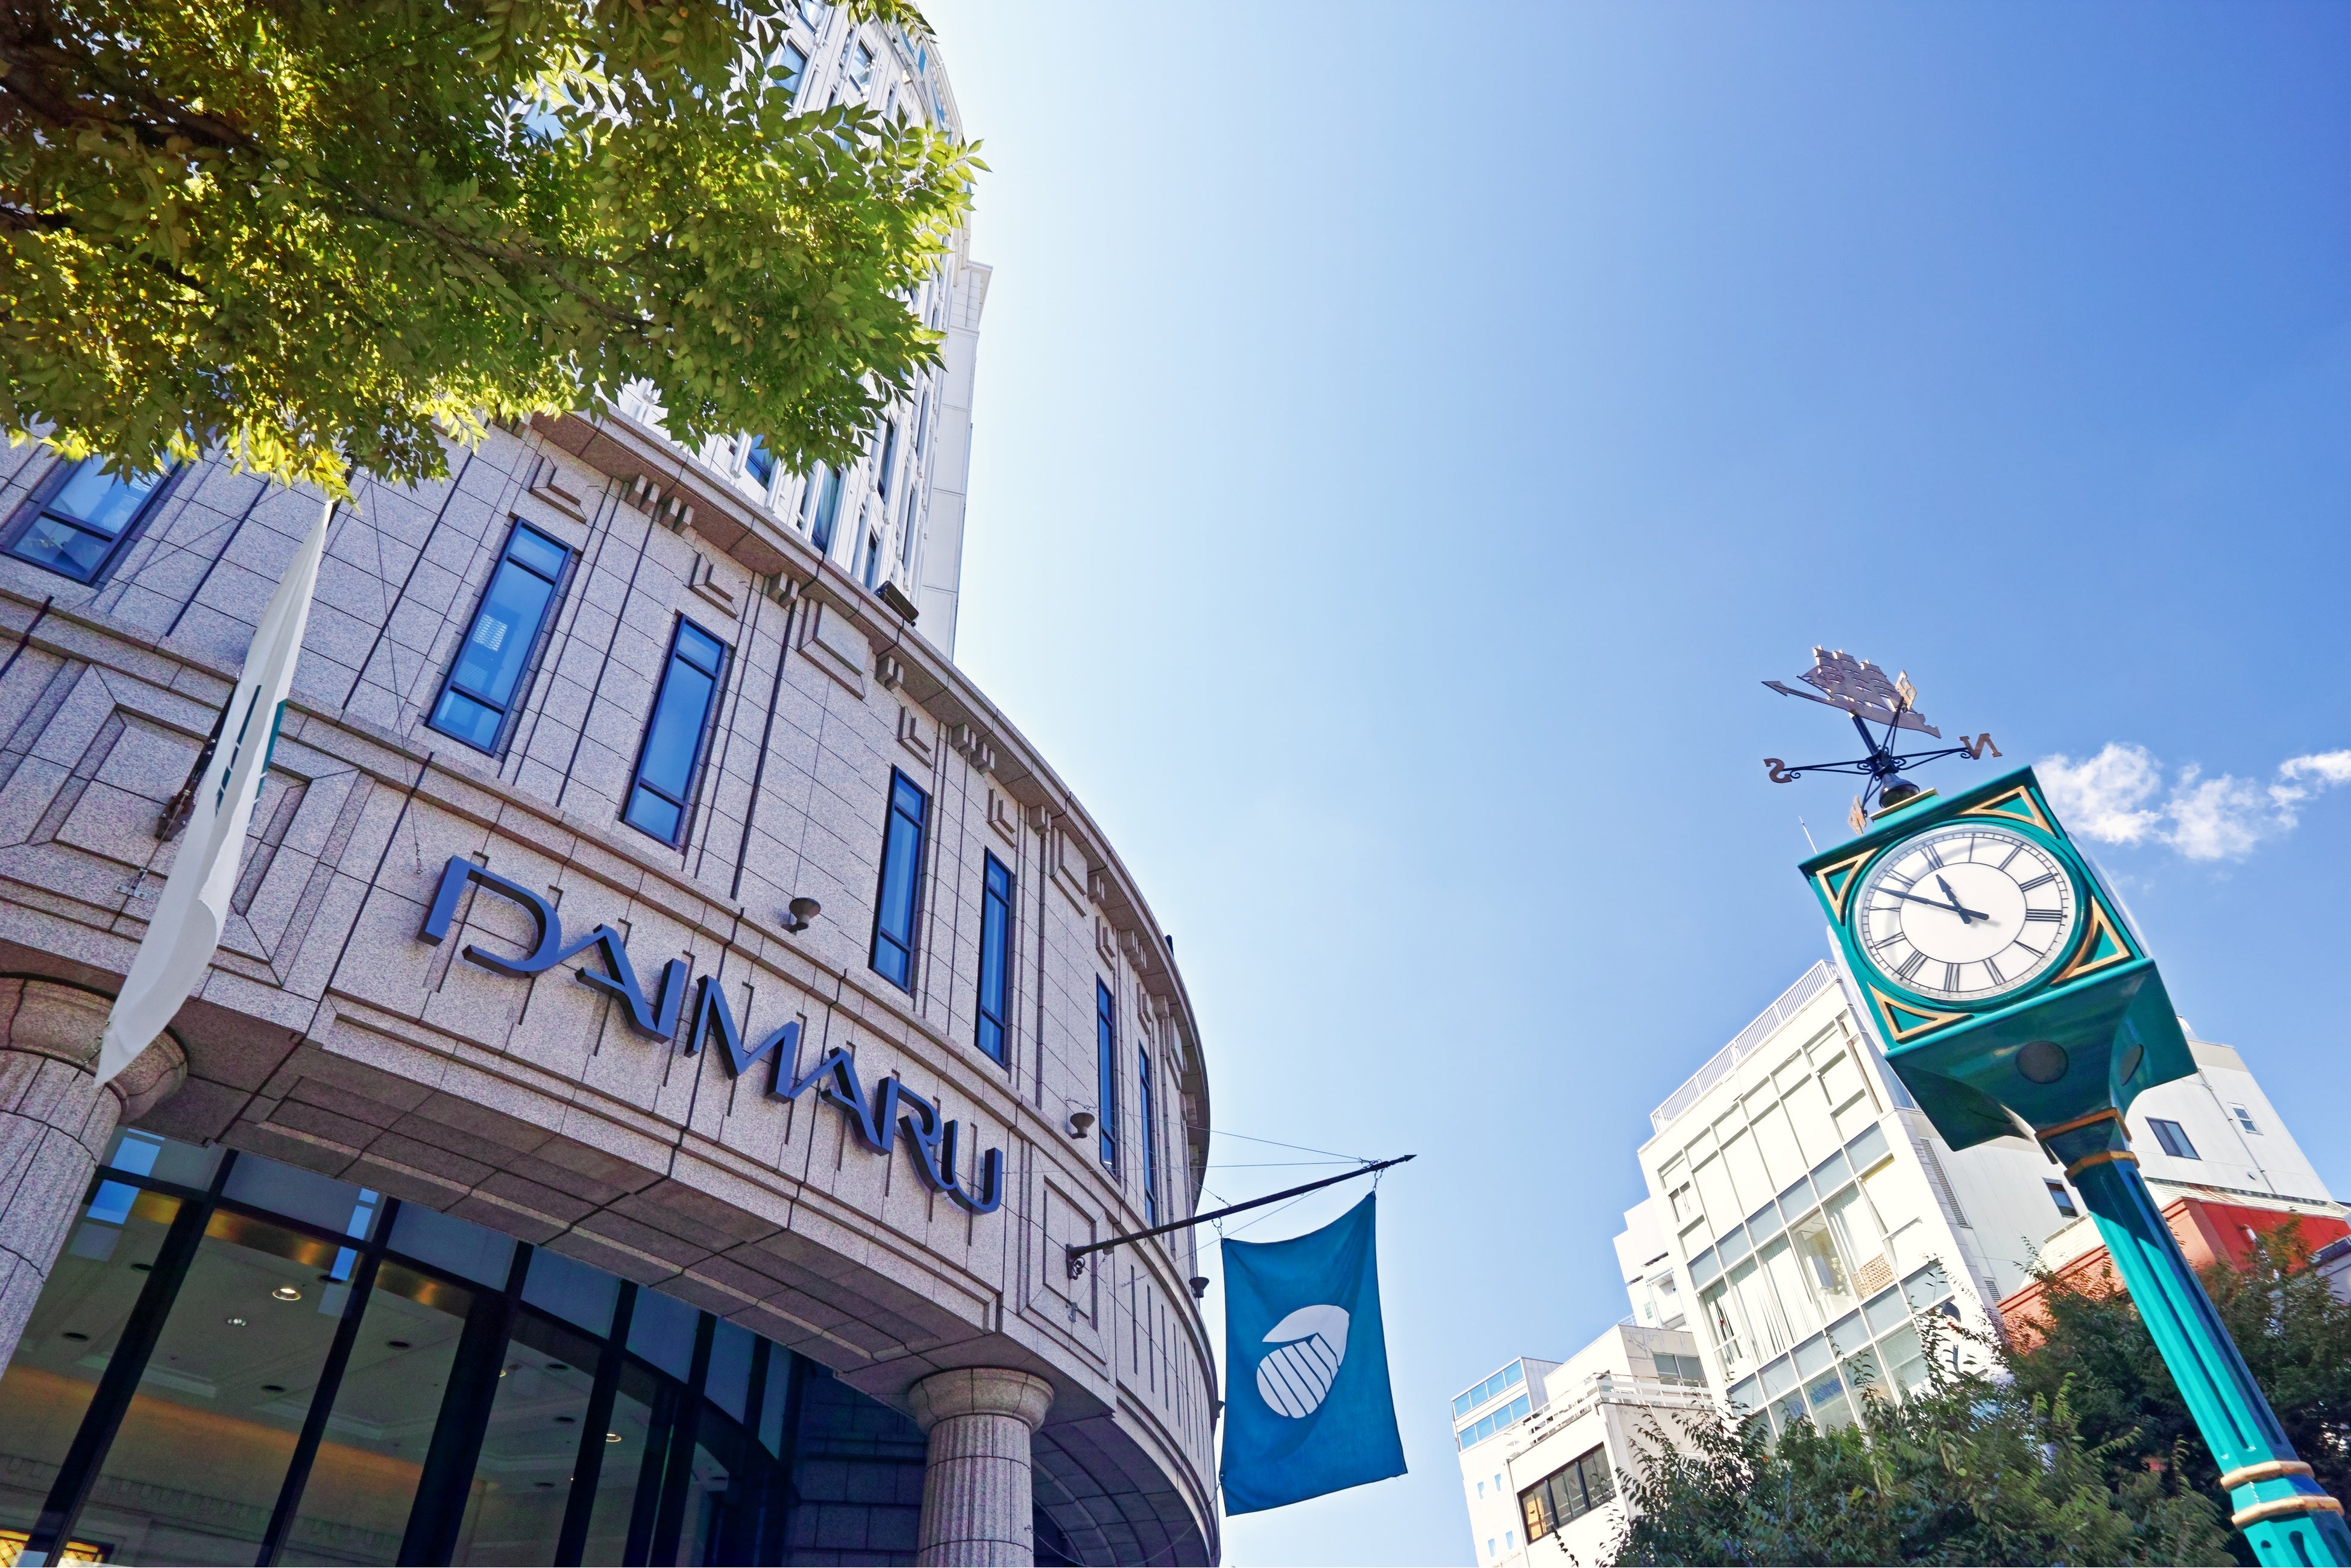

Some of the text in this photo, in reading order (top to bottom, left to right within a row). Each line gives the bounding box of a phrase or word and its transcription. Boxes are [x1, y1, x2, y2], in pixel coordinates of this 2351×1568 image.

[2019, 872, 2056, 892] III
[2025, 908, 2063, 922] IIII
[416, 855, 1003, 1214] DAIMARU
